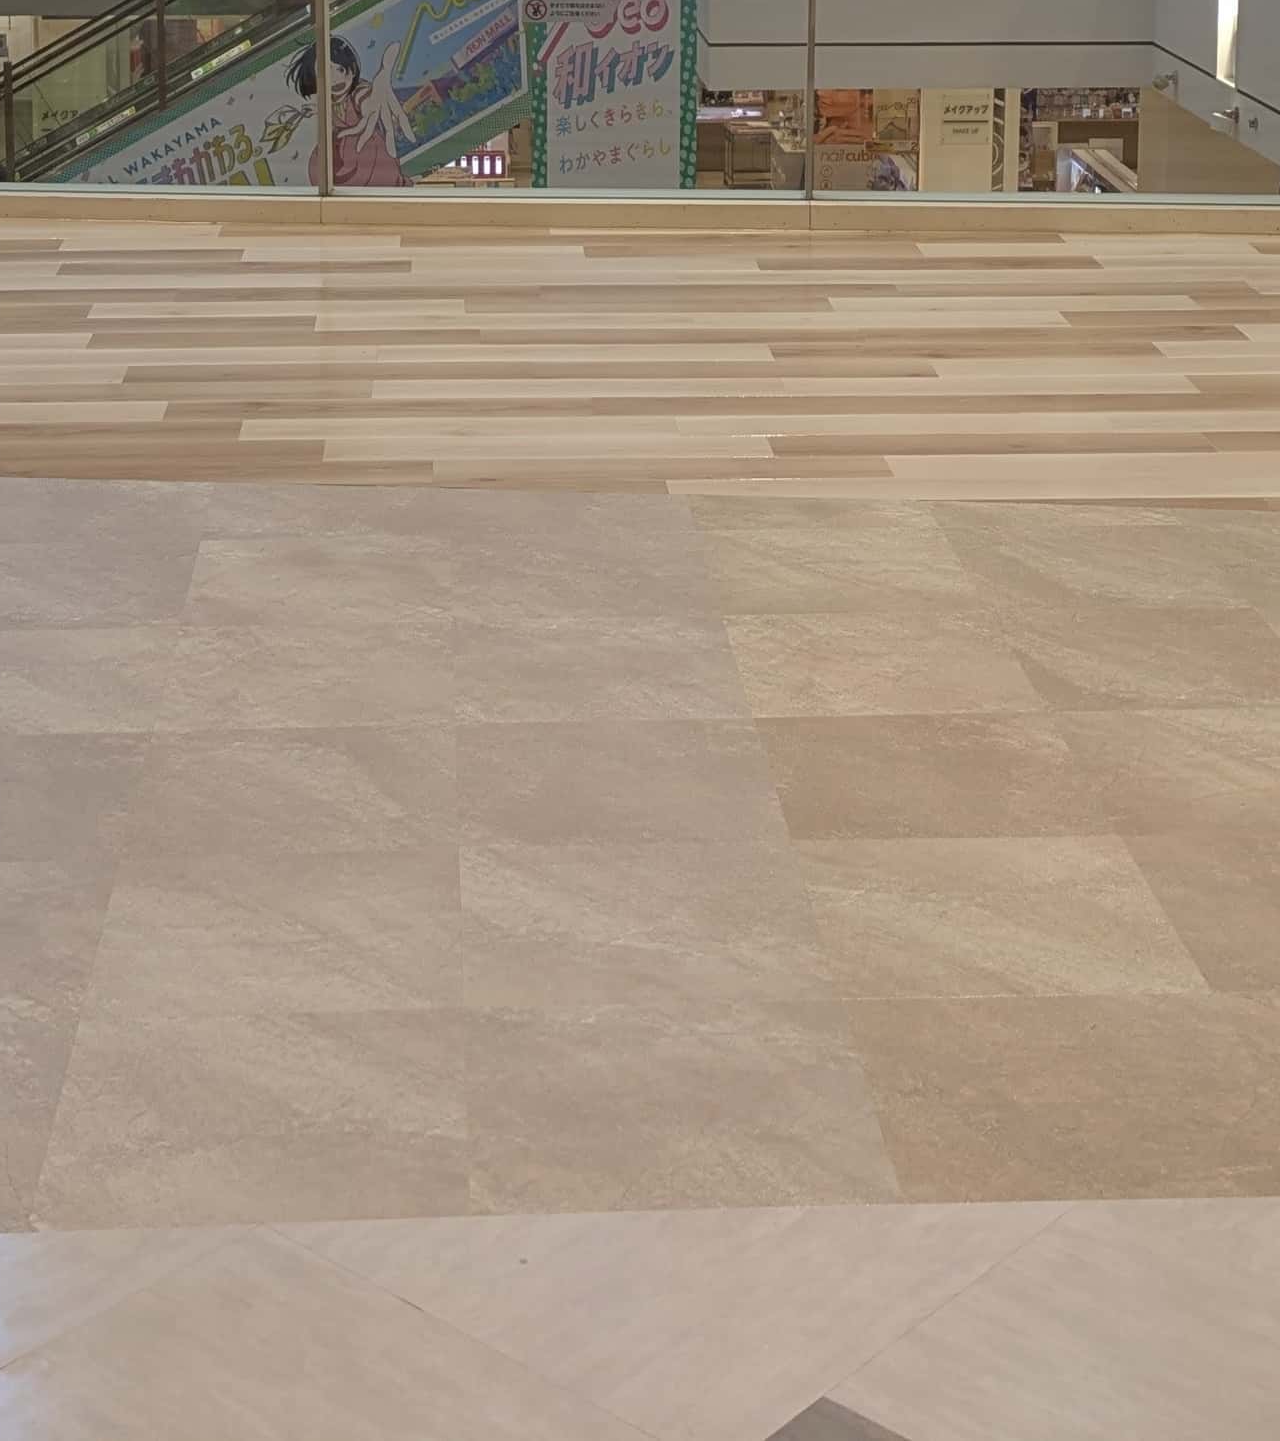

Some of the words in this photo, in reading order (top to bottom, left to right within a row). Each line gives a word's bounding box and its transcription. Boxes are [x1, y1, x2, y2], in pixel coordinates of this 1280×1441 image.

[553, 41, 674, 108] 和イオン
[943, 104, 990, 115] メイクアップ
[124, 117, 223, 176] WAKAYAMA
[135, 124, 263, 185] まれかわる。
[560, 140, 672, 174] わかやまぐらし
